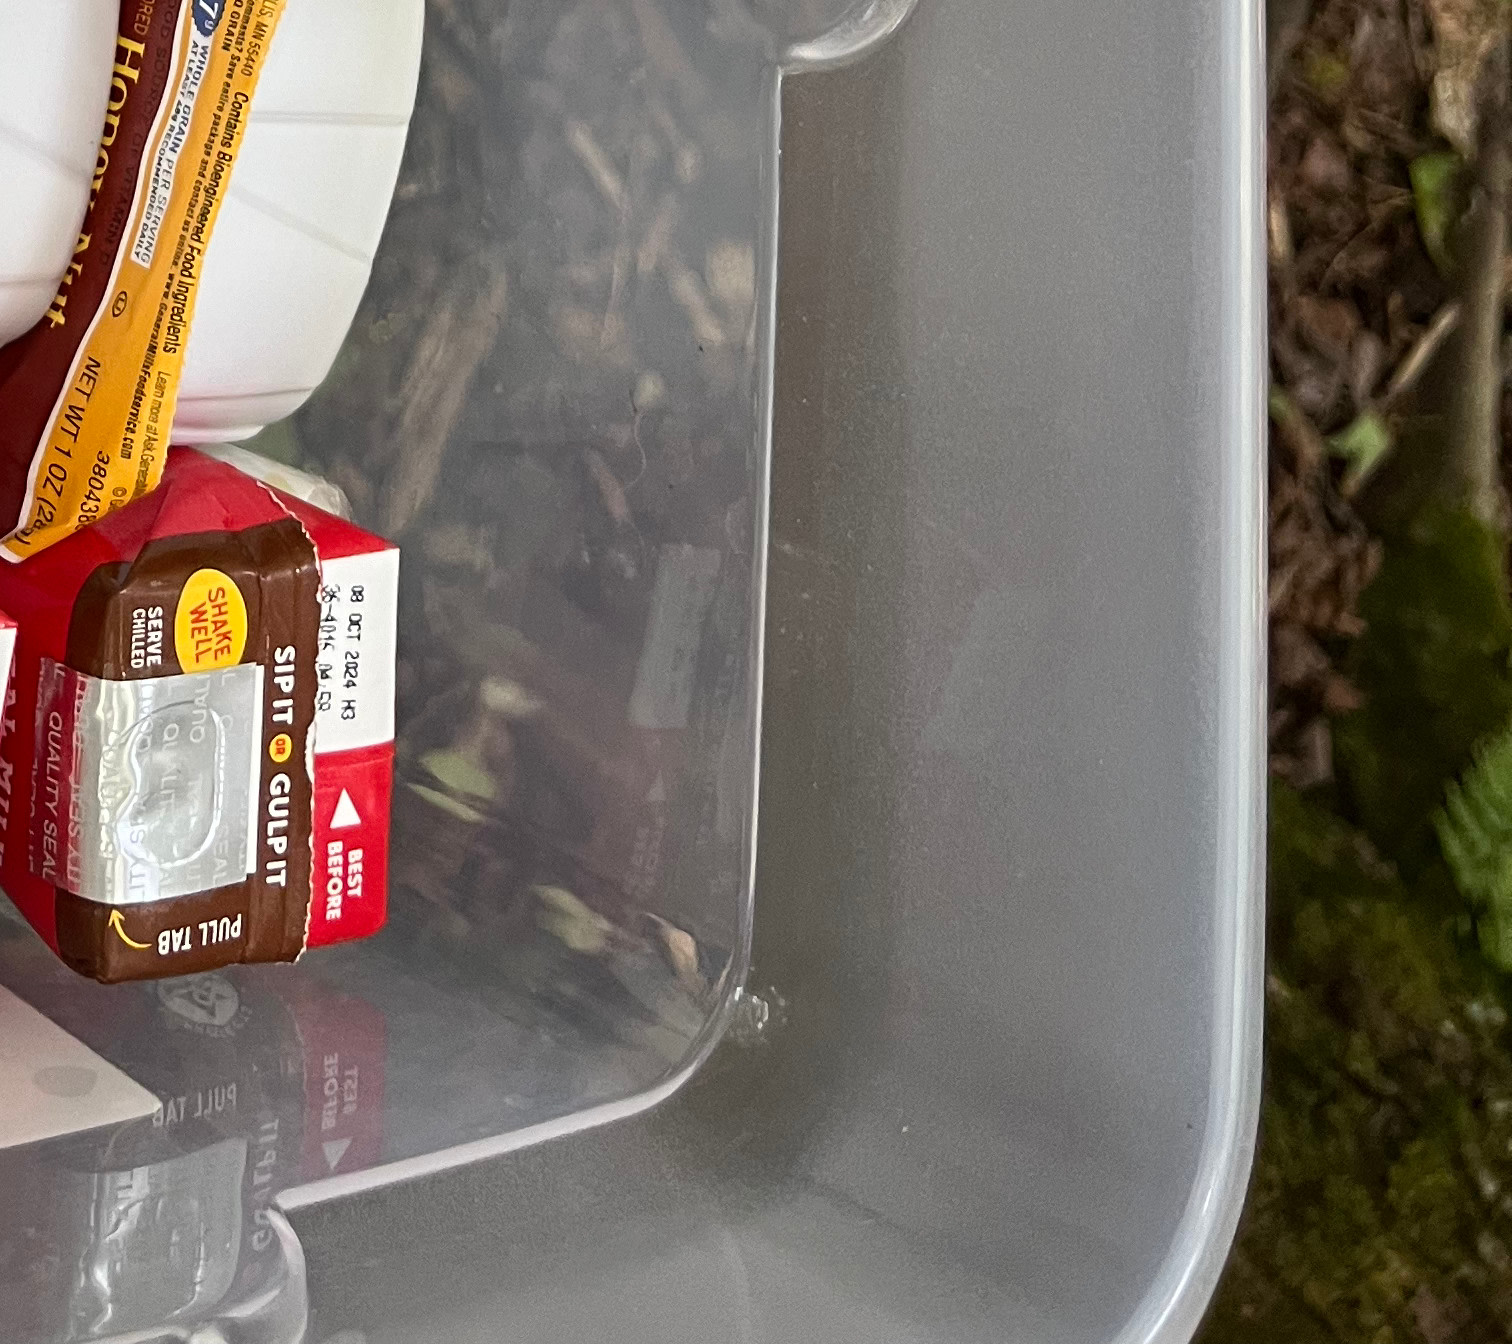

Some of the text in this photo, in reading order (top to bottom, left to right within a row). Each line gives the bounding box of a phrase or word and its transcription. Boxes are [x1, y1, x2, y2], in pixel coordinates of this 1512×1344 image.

[186, 44, 210, 102] WHOLE
[240, 40, 261, 78] 55440
[169, 102, 193, 154] GRAIN
[141, 192, 171, 265] SERVING
[162, 91, 250, 355] Contains Bioengineered Food Ingredients
[42, 356, 101, 498] NET WT OZ
[130, 607, 147, 670] CHILLED
[146, 604, 164, 668] SERVE
[189, 602, 215, 665] WELL
[208, 585, 233, 661] SHAKE
[342, 584, 366, 691] 08 OCT 2024
[265, 645, 297, 888] SIP IT GULP IT
[325, 840, 344, 922] BEFORE
[346, 848, 364, 899] BEST
[158, 912, 243, 956] PULL TAB
